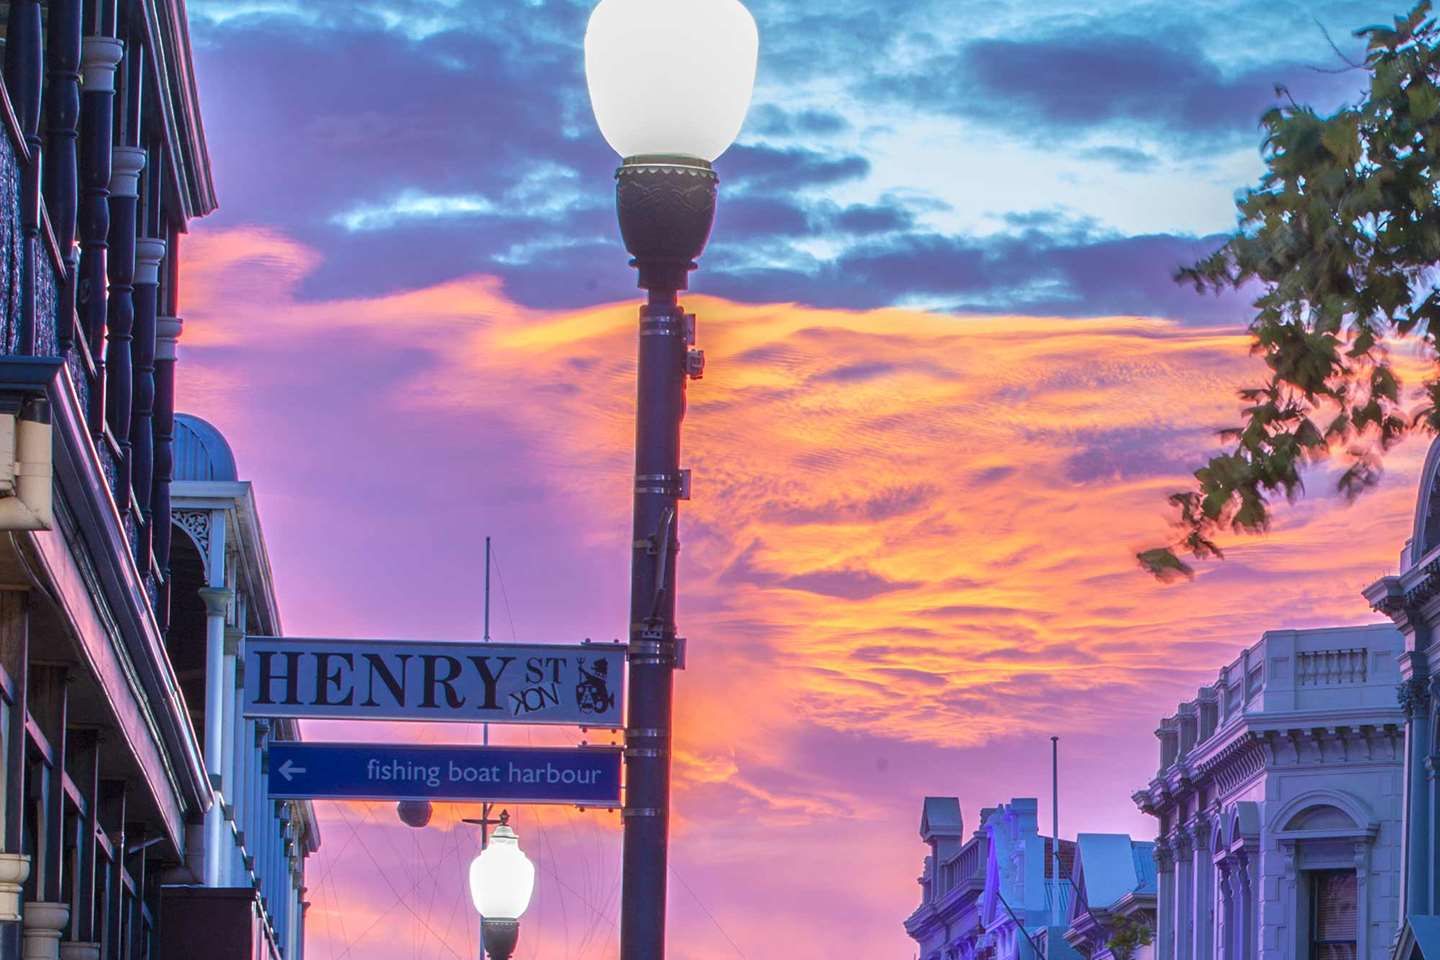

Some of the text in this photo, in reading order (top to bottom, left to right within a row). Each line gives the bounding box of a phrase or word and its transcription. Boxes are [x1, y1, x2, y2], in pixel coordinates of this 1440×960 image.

[252, 650, 567, 710] HENRY ST
[367, 758, 602, 788] fishing boat harbour
